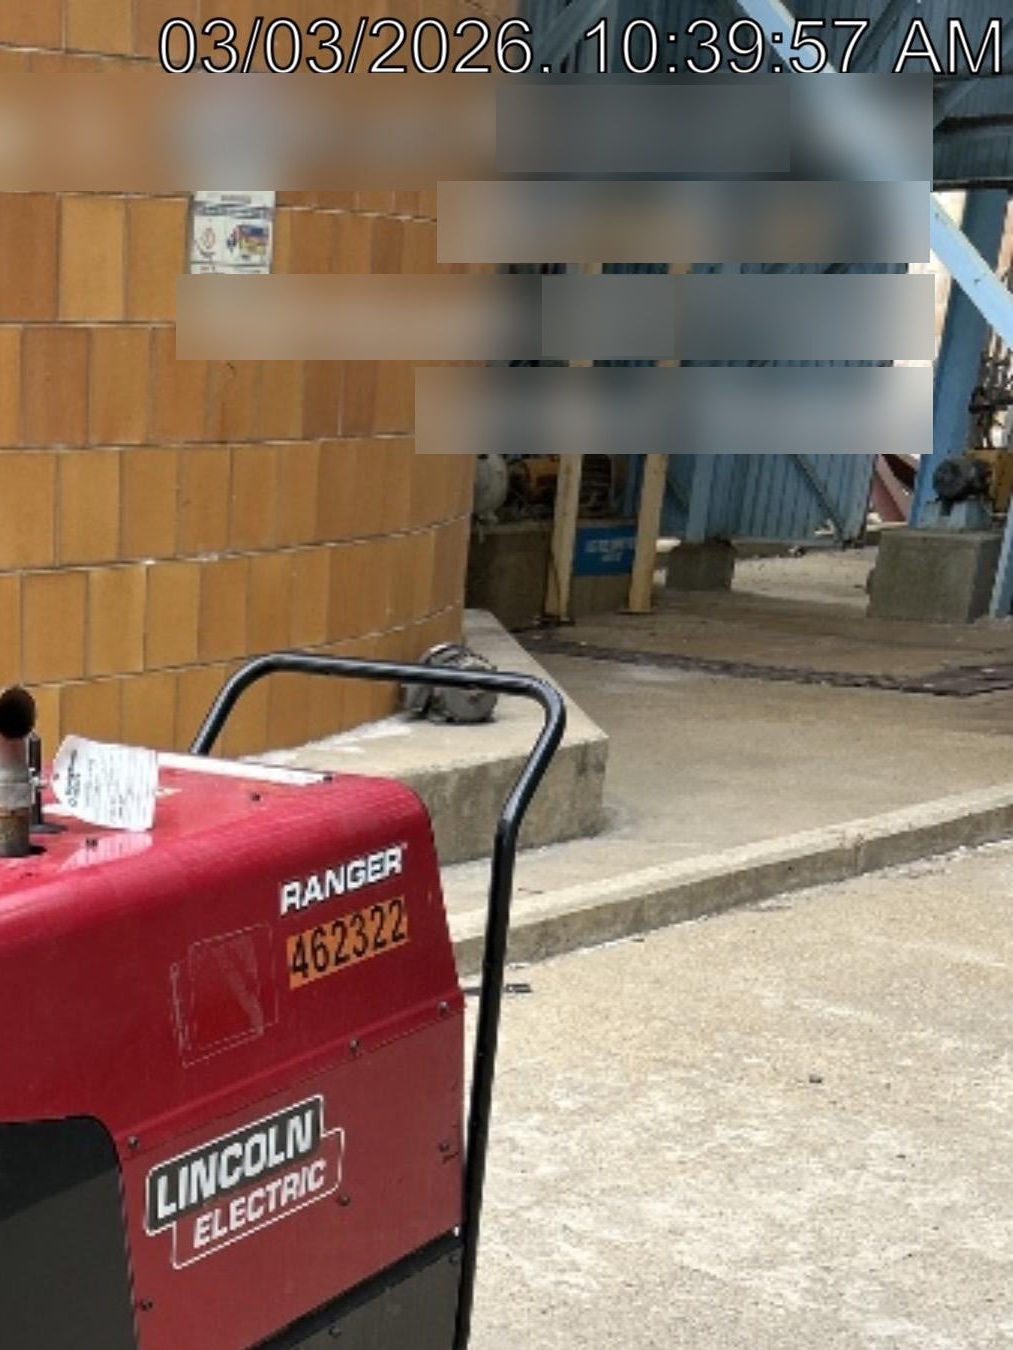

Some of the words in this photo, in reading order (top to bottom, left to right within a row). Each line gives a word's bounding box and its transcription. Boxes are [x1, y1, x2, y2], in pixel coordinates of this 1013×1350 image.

[279, 845, 404, 916] RANGER
[290, 899, 406, 978] 462322
[156, 1109, 314, 1220] LINCOLN
[193, 1158, 328, 1249] ELECTRIC
